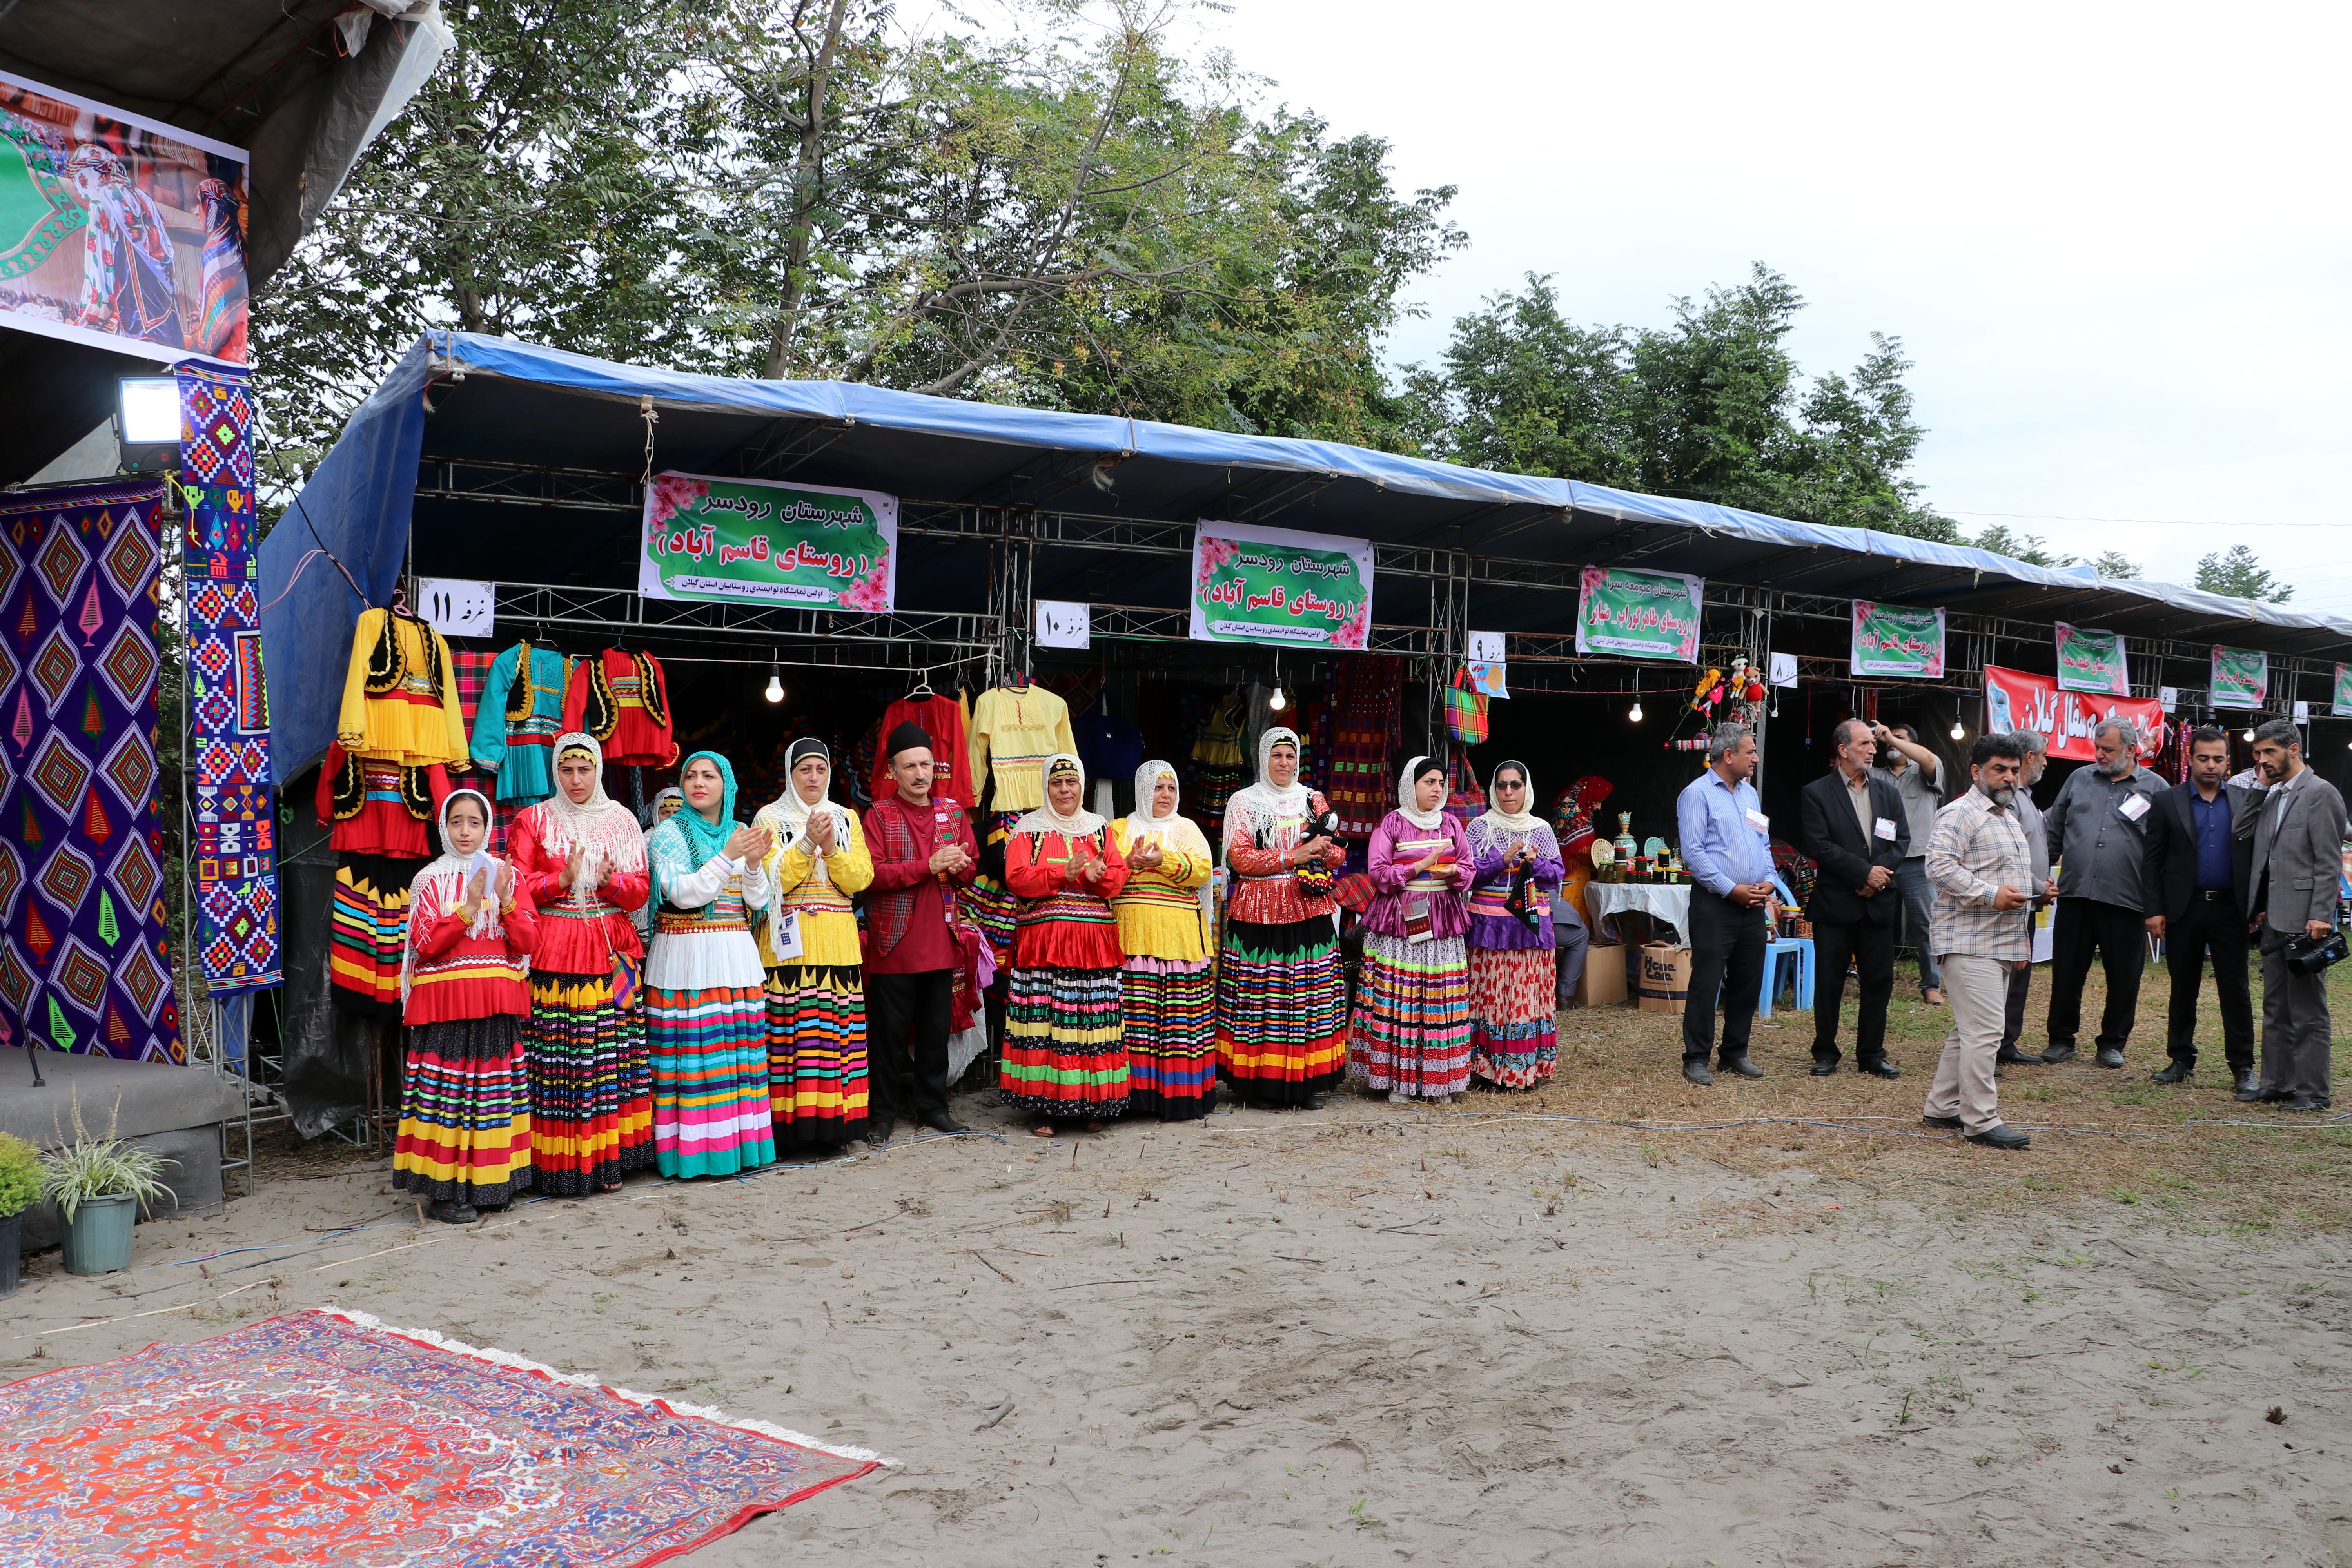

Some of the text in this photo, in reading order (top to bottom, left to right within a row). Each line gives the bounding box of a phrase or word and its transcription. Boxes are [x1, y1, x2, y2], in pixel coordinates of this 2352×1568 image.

[701, 495, 862, 529] شهرستان رودسر
[720, 535, 768, 565] قاسم
[1234, 554, 1350, 580] شهرستان رودسر
[682, 579, 699, 587] گیلان
[750, 586, 779, 595] توانمندی
[780, 587, 806, 595] نمایشگاه
[1607, 575, 1687, 601] شهرستان صومعه سرا
[807, 590, 823, 599] اولین
[1246, 585, 1285, 612] قاسم
[434, 591, 486, 624] غرفه ۱۱
[1046, 611, 1083, 638] غرفه ۱۰
[1872, 611, 1933, 626] شهرستان رودسر
[1880, 633, 1898, 653] قاسم
[1489, 645, 1501, 661] غرفه
[1644, 956, 1677, 971] Home
[1646, 968, 1673, 981] Care
